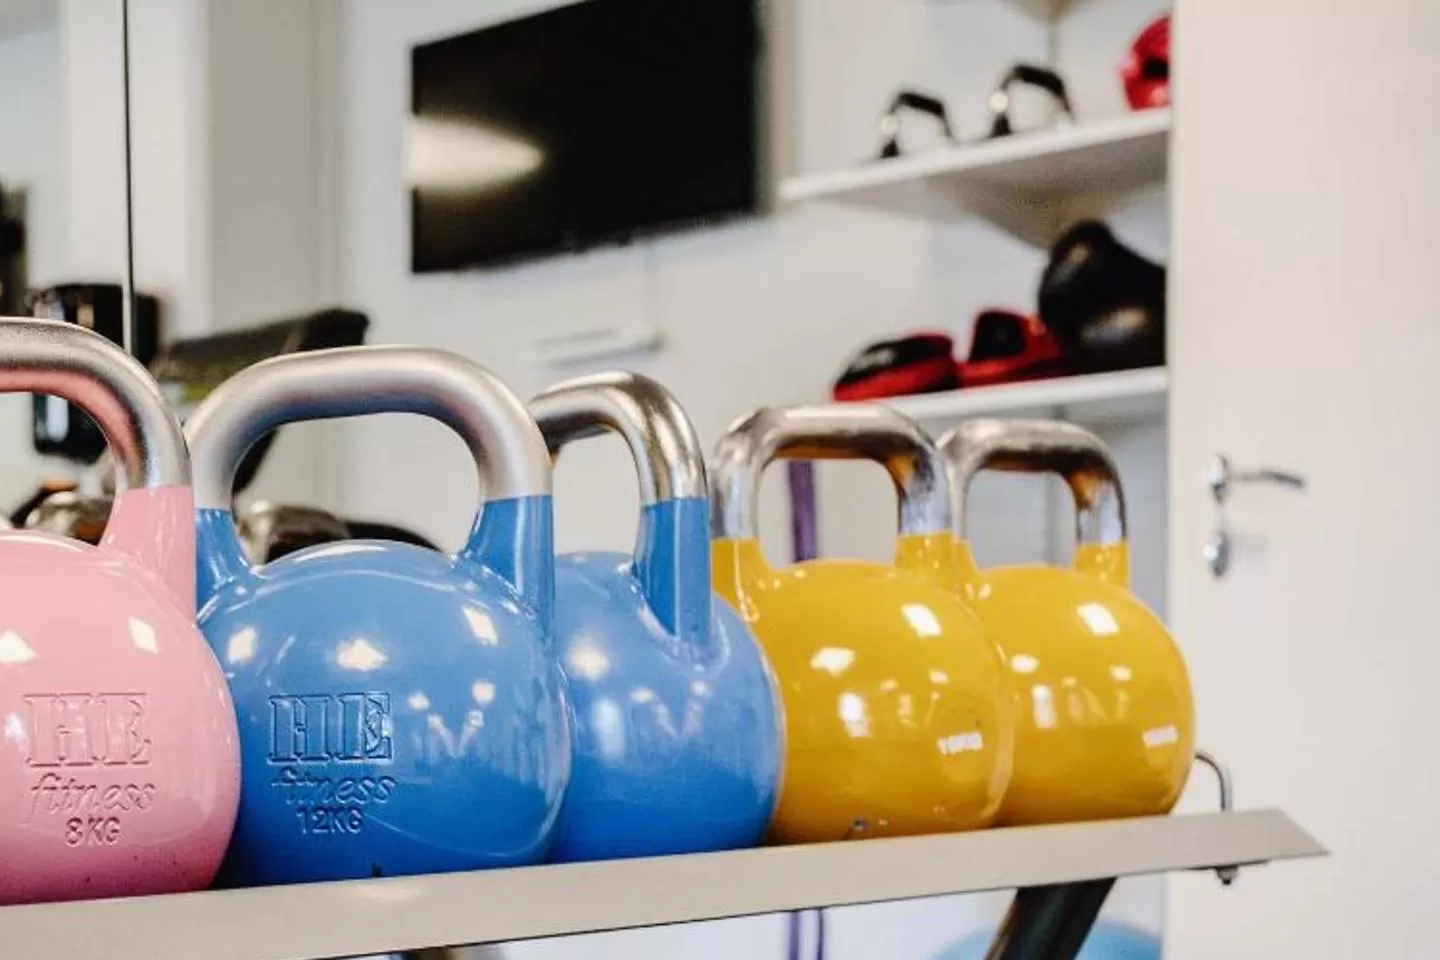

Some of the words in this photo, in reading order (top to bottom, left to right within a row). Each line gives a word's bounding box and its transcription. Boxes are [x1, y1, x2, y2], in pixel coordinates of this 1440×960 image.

[22, 772, 158, 824] fitness
[271, 766, 397, 806] fitness
[65, 816, 121, 846] 8KG
[295, 804, 364, 835] 12KG
